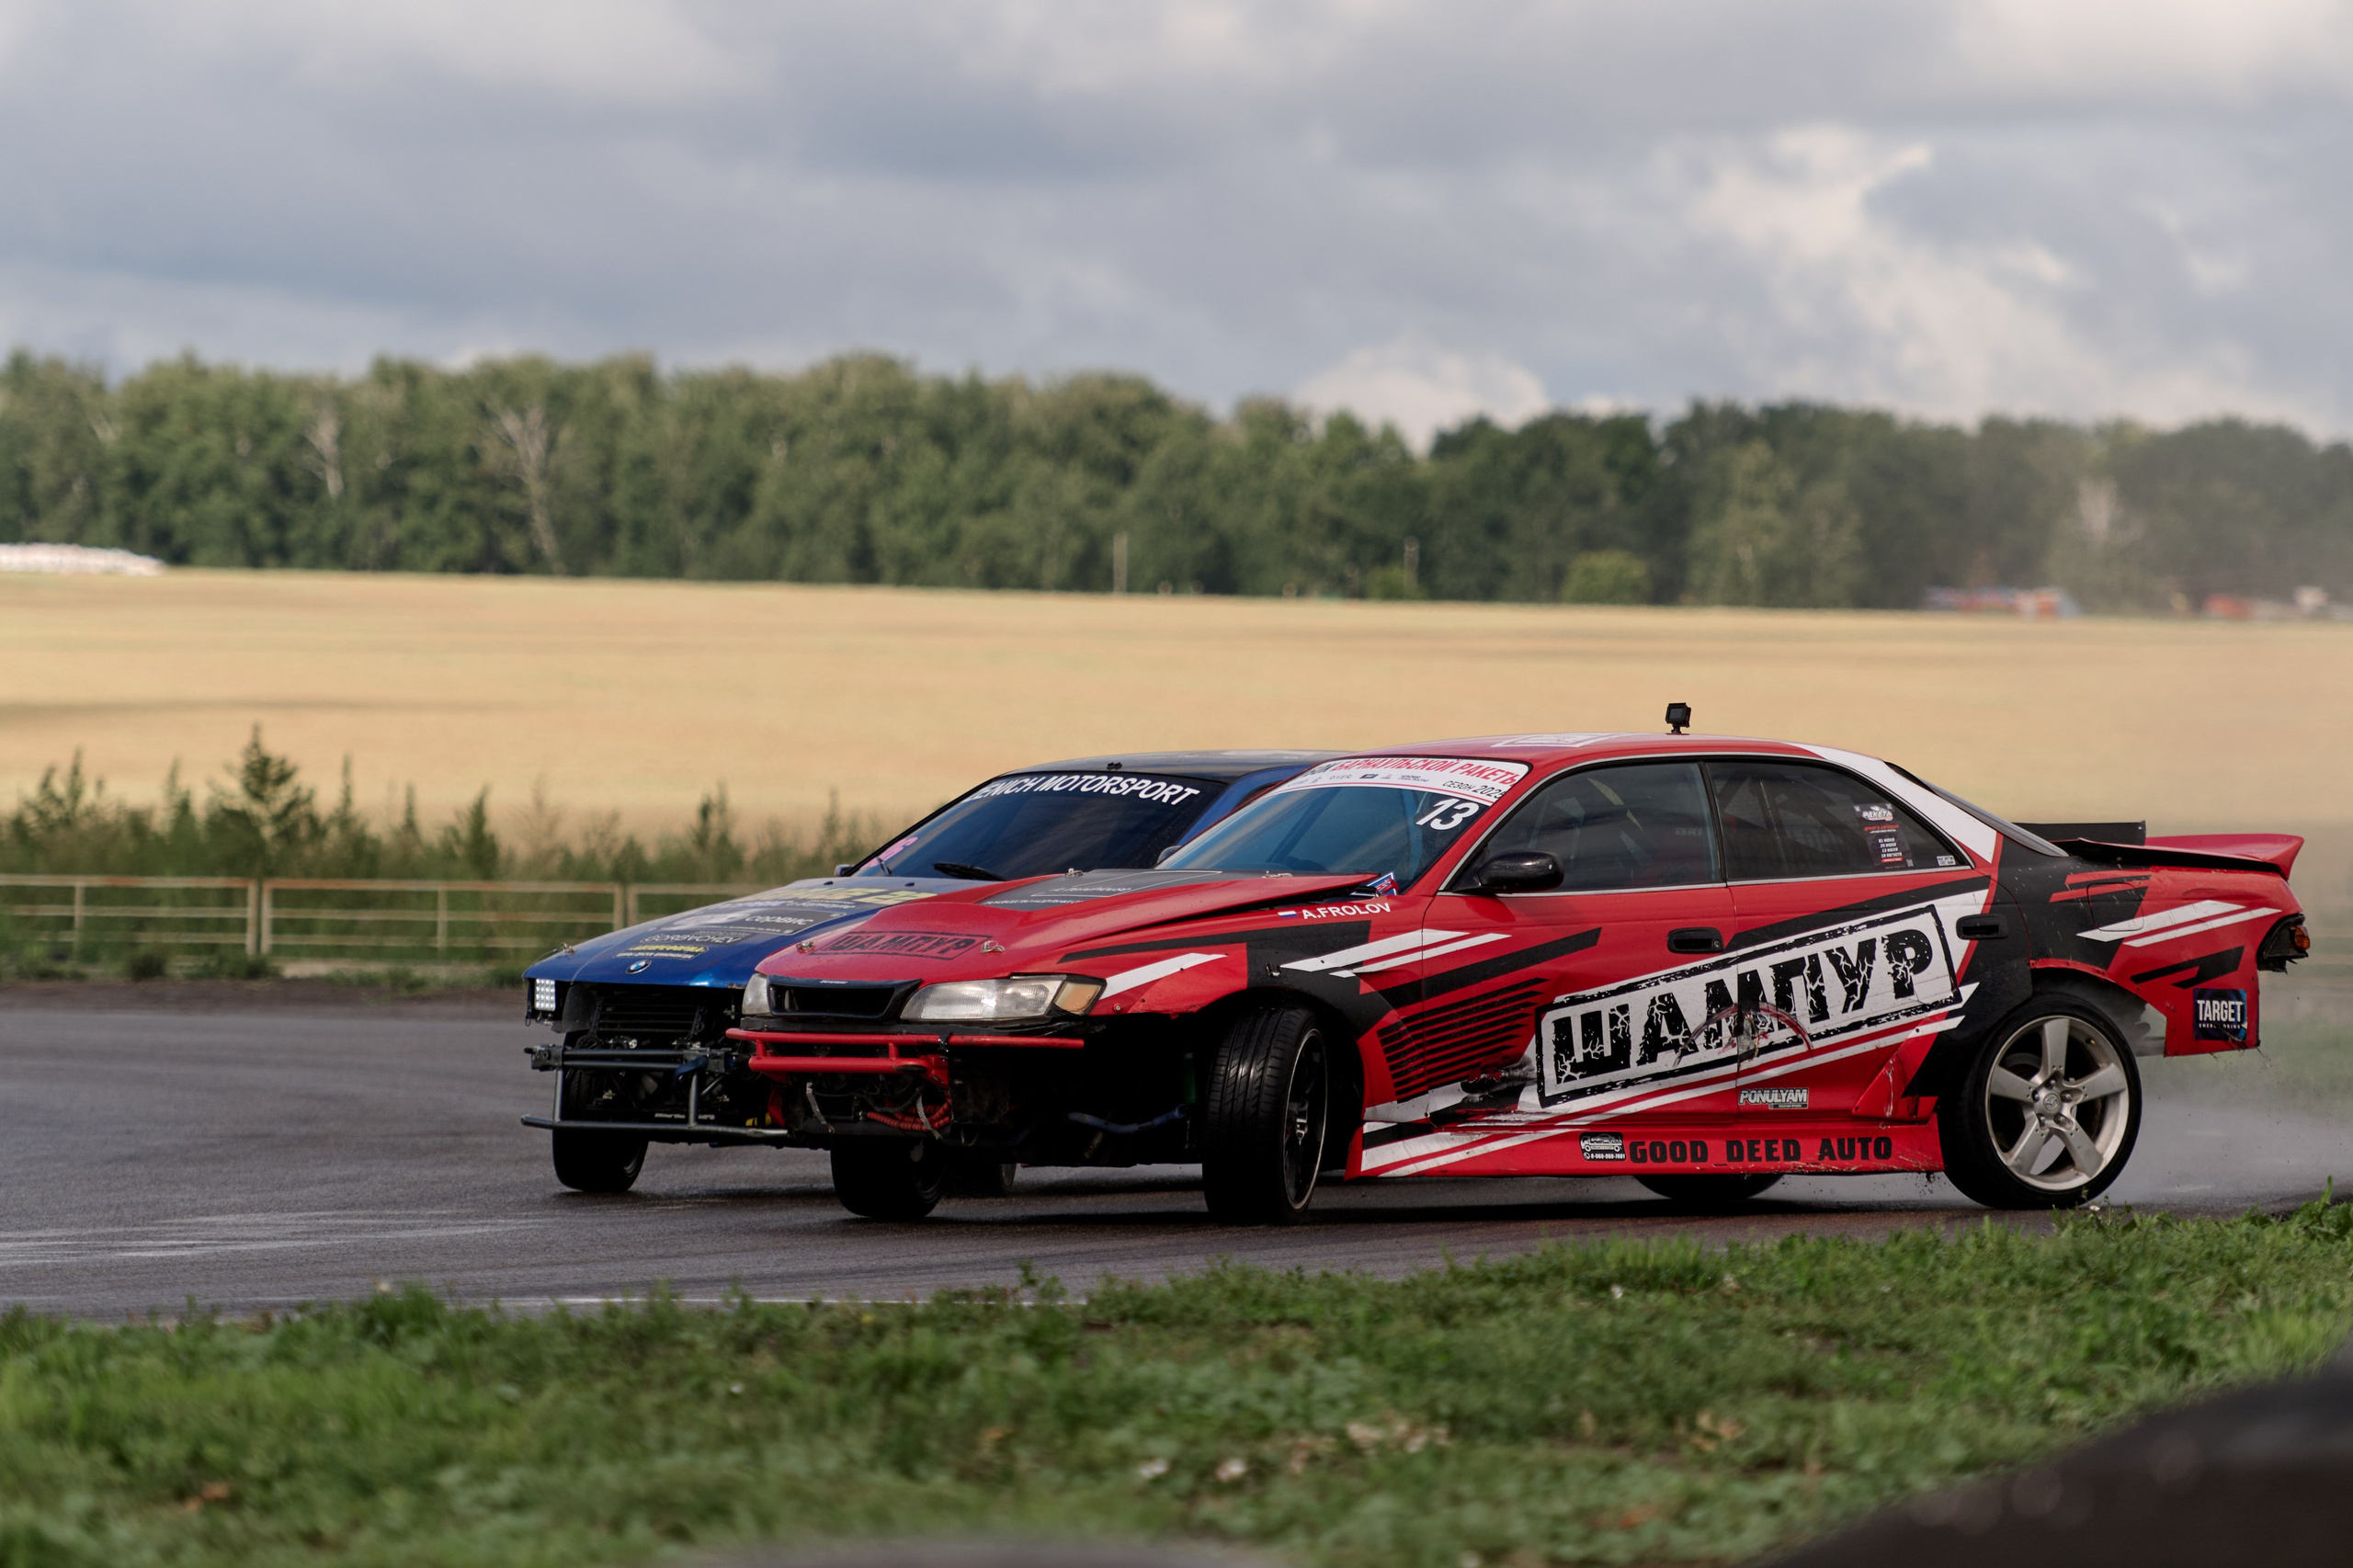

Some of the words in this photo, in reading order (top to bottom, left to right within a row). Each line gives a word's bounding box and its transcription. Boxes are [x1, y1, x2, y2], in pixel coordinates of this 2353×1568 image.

[1034, 775, 1199, 805] MOTORSPORT
[1442, 780, 1474, 791] СЕЗОН
[1415, 798, 1480, 831] 13
[1302, 903, 1391, 919] A.FROLOV
[826, 935, 976, 955] ШАМПУР
[1553, 929, 1934, 1085] ШАМПУР
[2197, 1000, 2245, 1022] TARGET
[1739, 1088, 1808, 1104] PONULYAM
